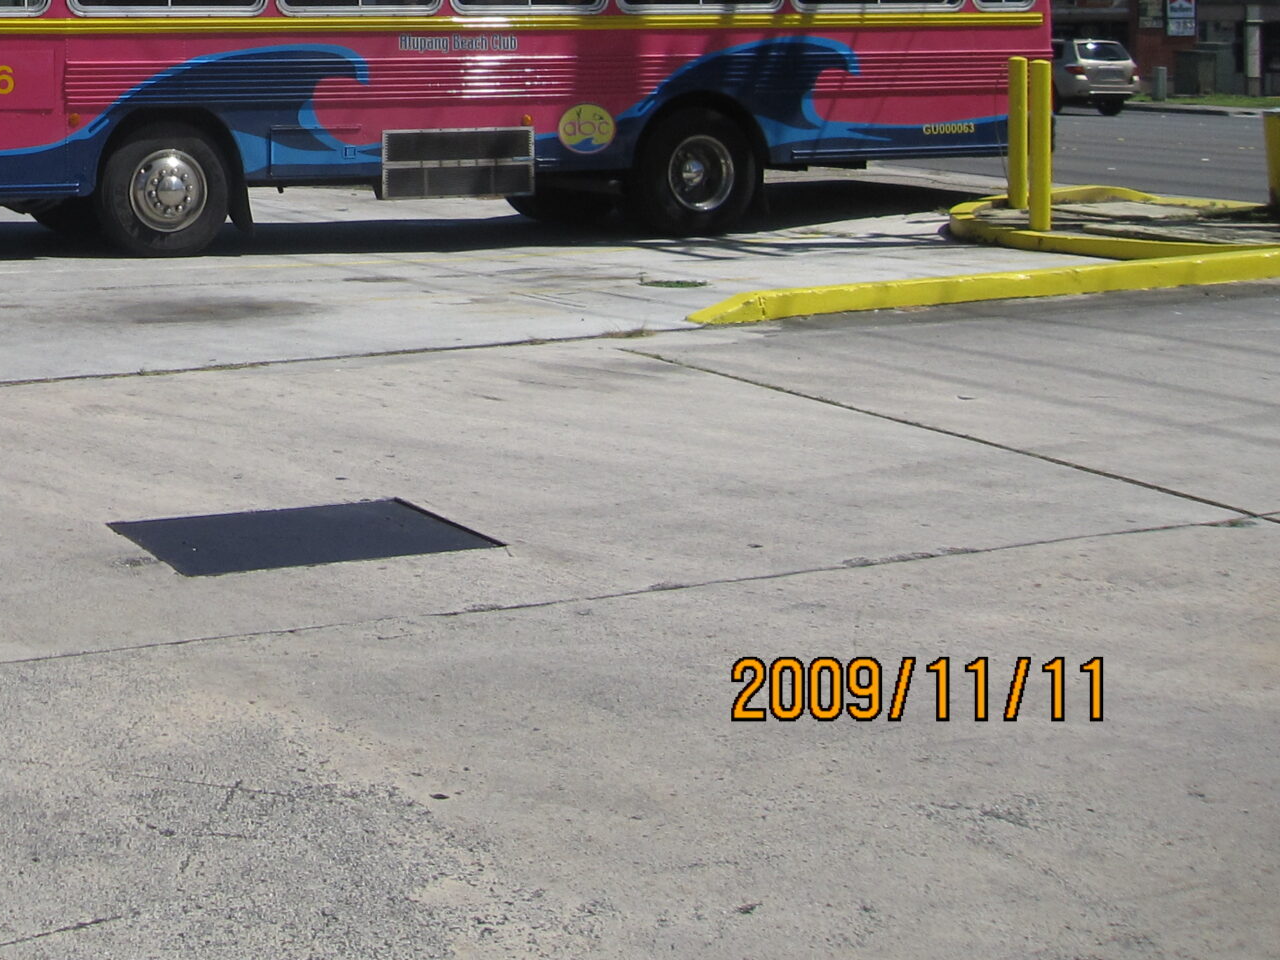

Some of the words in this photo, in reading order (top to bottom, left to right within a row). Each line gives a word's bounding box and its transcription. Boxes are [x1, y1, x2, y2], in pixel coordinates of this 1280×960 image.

[451, 33, 489, 51] Beach
[491, 33, 518, 51] Club
[563, 113, 610, 137] abc
